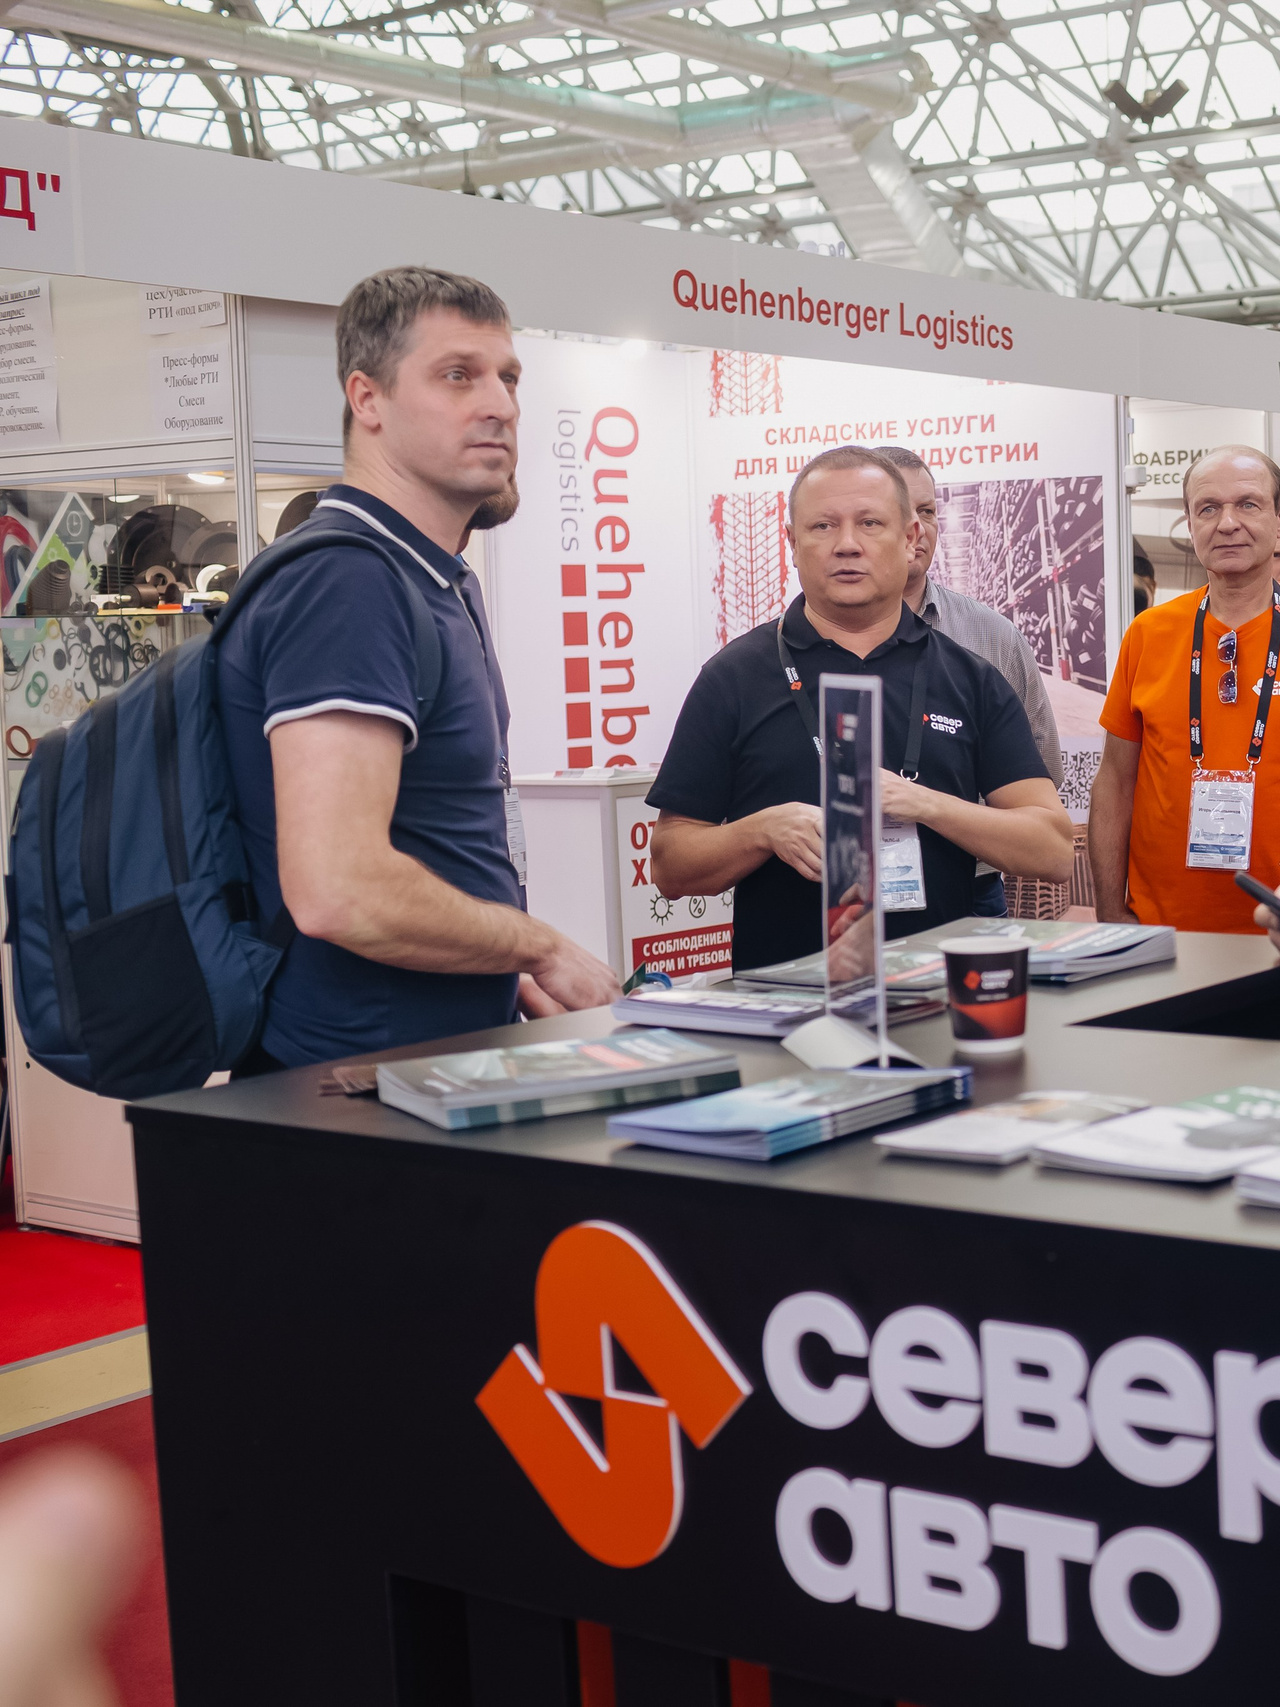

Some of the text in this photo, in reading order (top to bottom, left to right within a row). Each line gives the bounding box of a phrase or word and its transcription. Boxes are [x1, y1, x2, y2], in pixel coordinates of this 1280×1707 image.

[148, 306, 173, 319] РТИ
[673, 269, 1014, 351] Quehenberger Logistics
[162, 353, 219, 370] Пресс-формы
[0, 371, 45, 384] ологический
[200, 371, 219, 384] РТИ
[178, 395, 205, 407] Смеси
[164, 416, 223, 431] Оборудование
[764, 414, 996, 445] СКЛАДСКИЕ УСЛУГИ
[1133, 449, 1208, 466] ФАБРИ
[734, 457, 777, 480] ДЛЯ
[786, 455, 811, 474] Ш
[553, 409, 584, 552] logistics
[930, 713, 963, 729] север
[930, 721, 957, 735] авто
[643, 930, 731, 957] С СОБЛЮДЕНИЕМ
[677, 956, 685, 970] И
[687, 948, 732, 968] ТРЕБОВА
[774, 1467, 1222, 1677] авто
